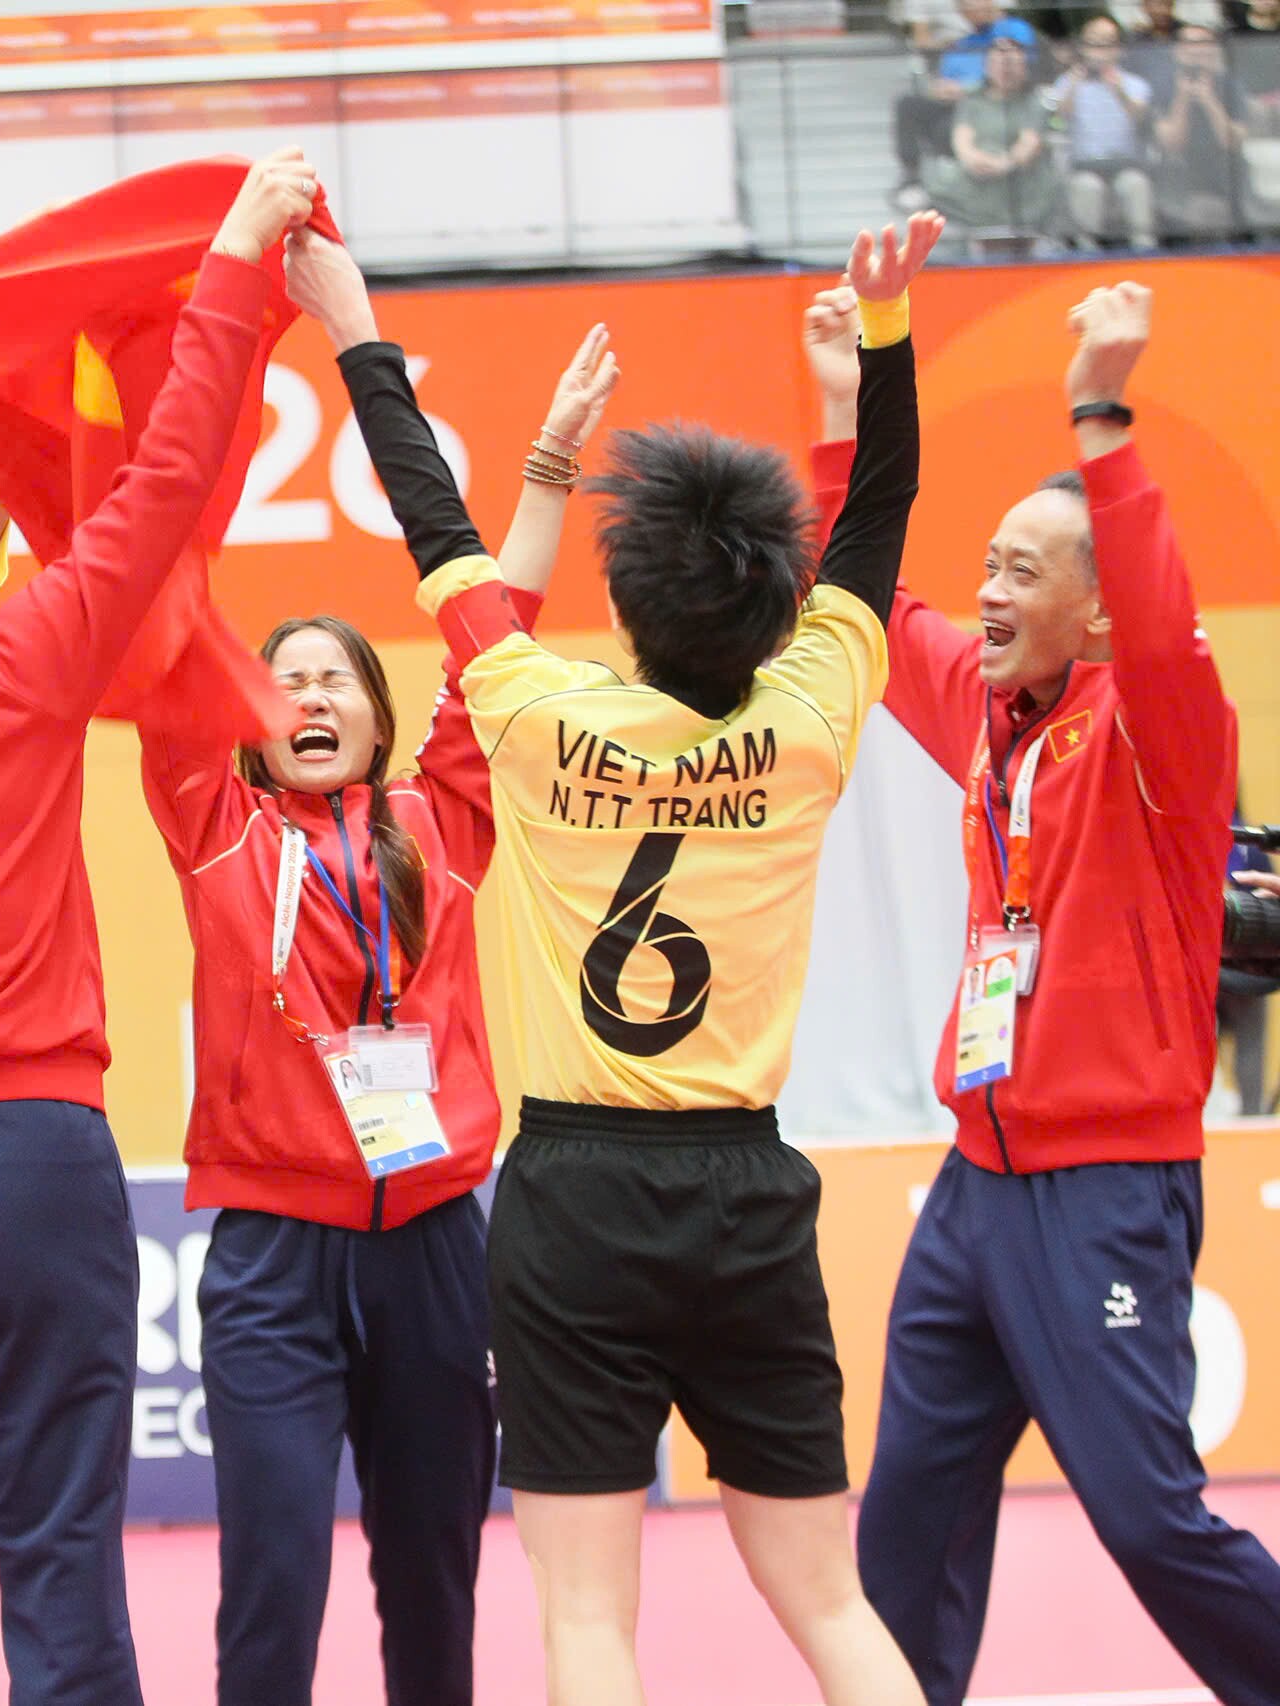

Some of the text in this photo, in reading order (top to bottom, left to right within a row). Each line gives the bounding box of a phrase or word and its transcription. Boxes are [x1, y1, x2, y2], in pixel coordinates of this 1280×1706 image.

[557, 719, 778, 788] VIET NAM
[647, 788, 768, 829] TRANG
[579, 832, 713, 1058] 6
